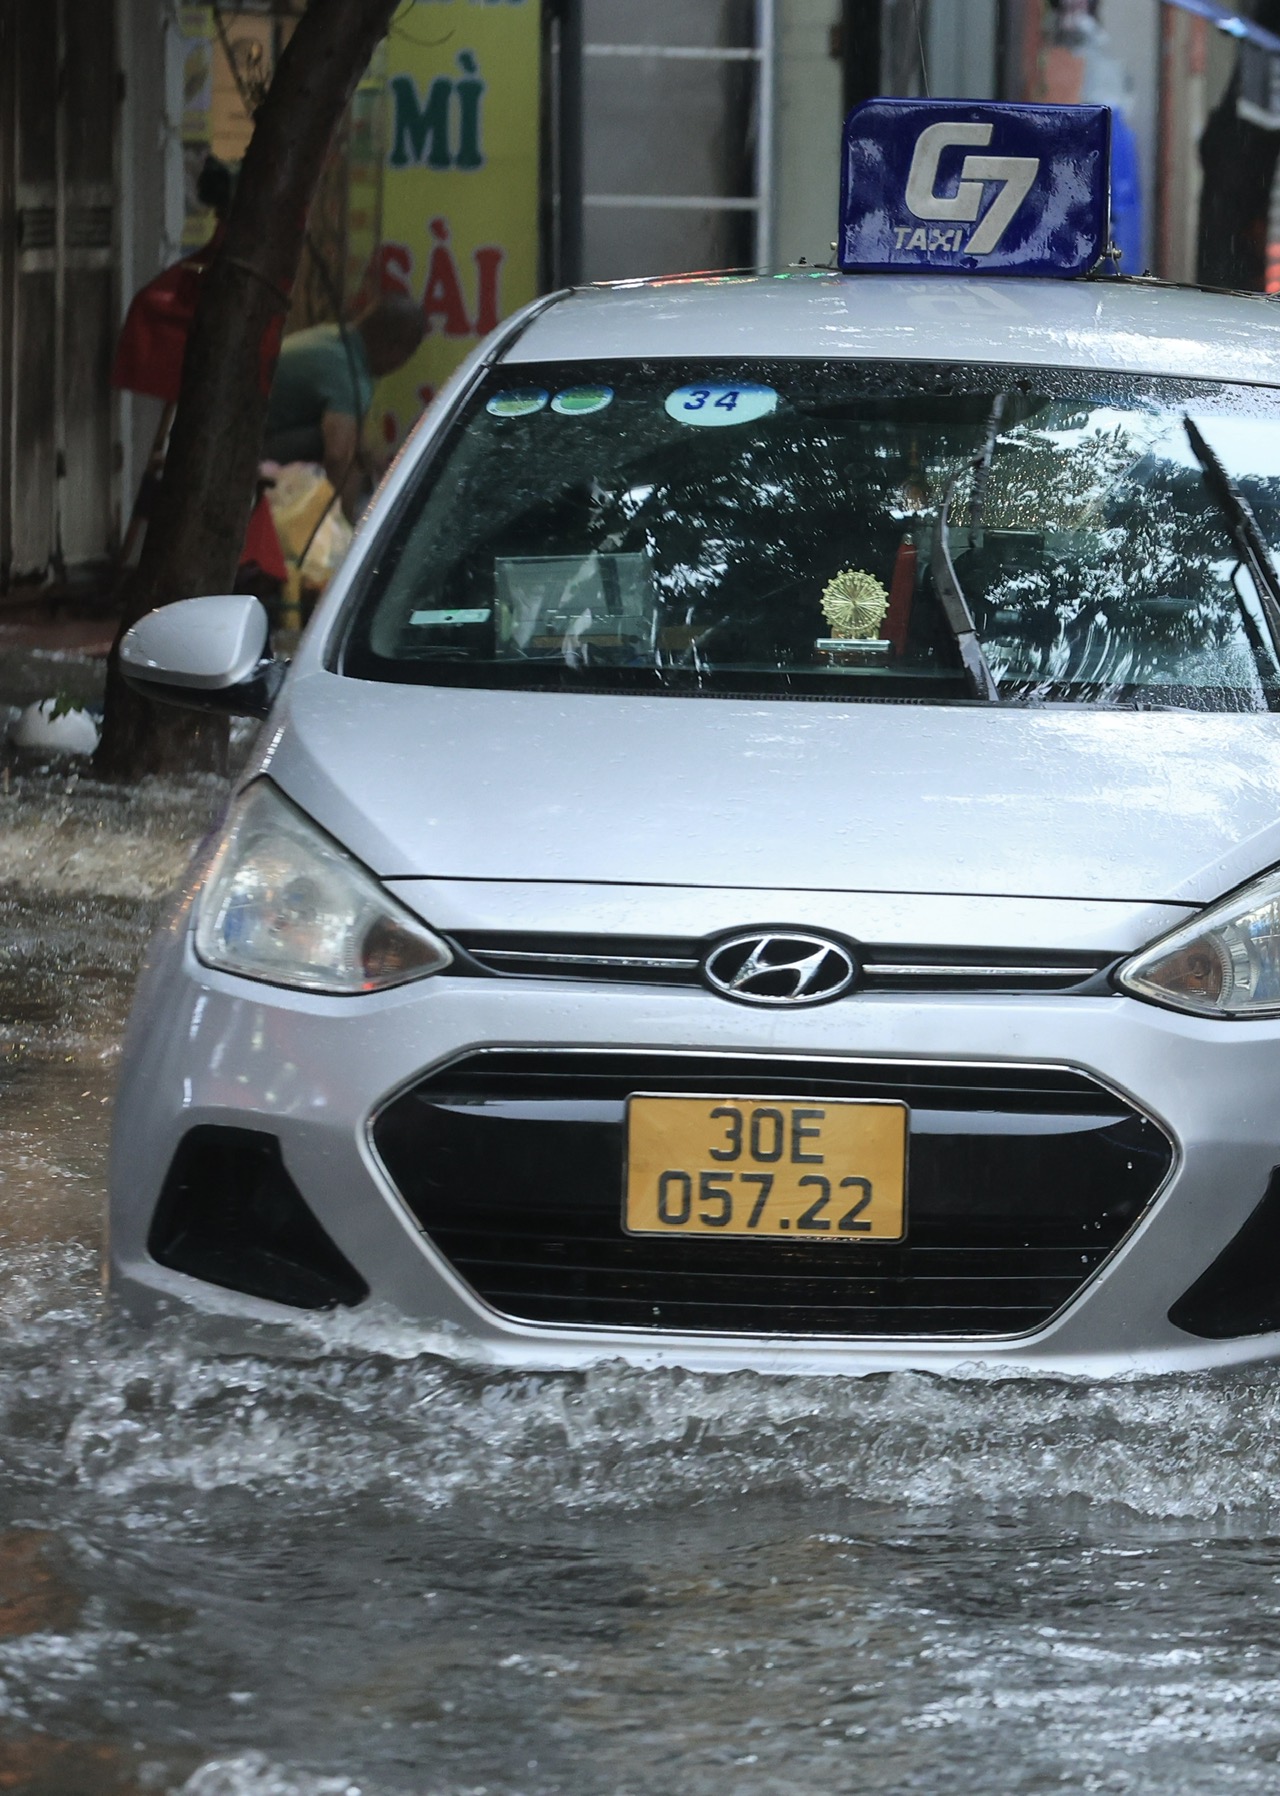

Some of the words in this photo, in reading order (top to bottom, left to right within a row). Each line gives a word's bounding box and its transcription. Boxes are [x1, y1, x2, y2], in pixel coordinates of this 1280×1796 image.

[390, 50, 485, 168] MÌ
[906, 121, 1040, 255] G7
[893, 227, 962, 252] TAXI
[685, 390, 740, 411] 34
[709, 1107, 825, 1163] 30E
[658, 1170, 872, 1231] 057.22
